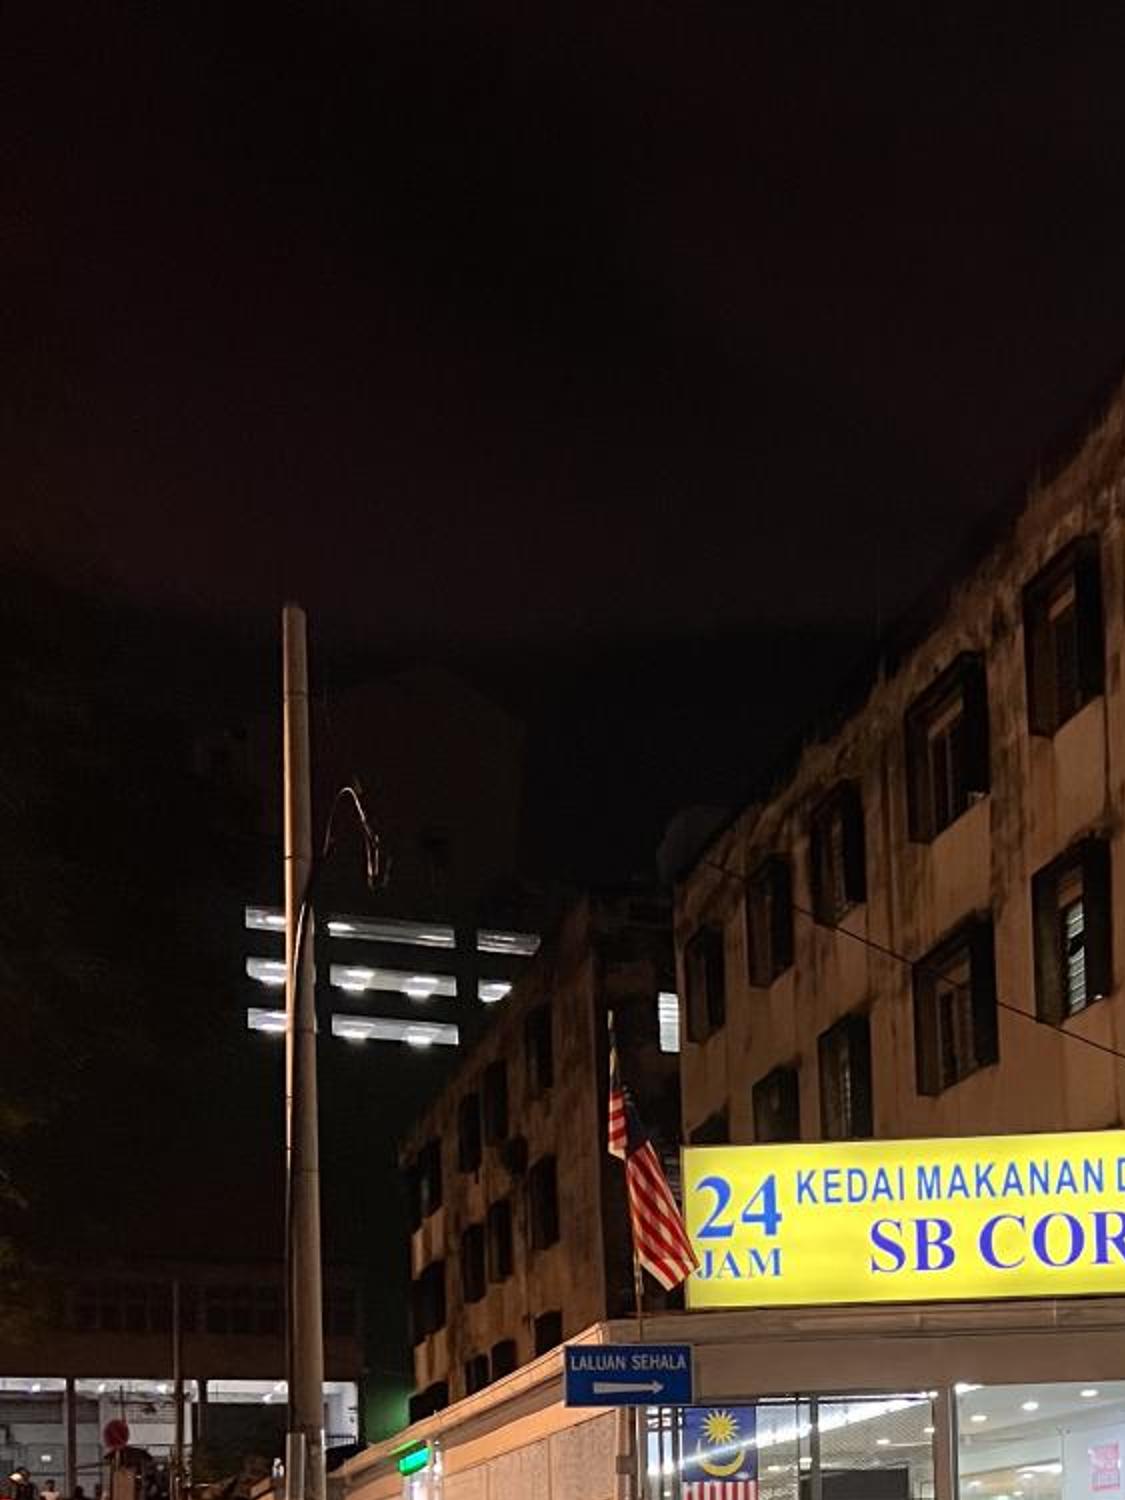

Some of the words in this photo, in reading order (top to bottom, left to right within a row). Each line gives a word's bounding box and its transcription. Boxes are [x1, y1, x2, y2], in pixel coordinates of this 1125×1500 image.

[796, 1166, 905, 1204] KEDAI
[915, 1156, 1105, 1200] MAKANAN
[695, 1174, 783, 1240] 24
[696, 1247, 783, 1279] JAM
[870, 1217, 956, 1273] SB
[571, 1354, 627, 1371] LALUAN
[631, 1353, 687, 1370] SEHALA
